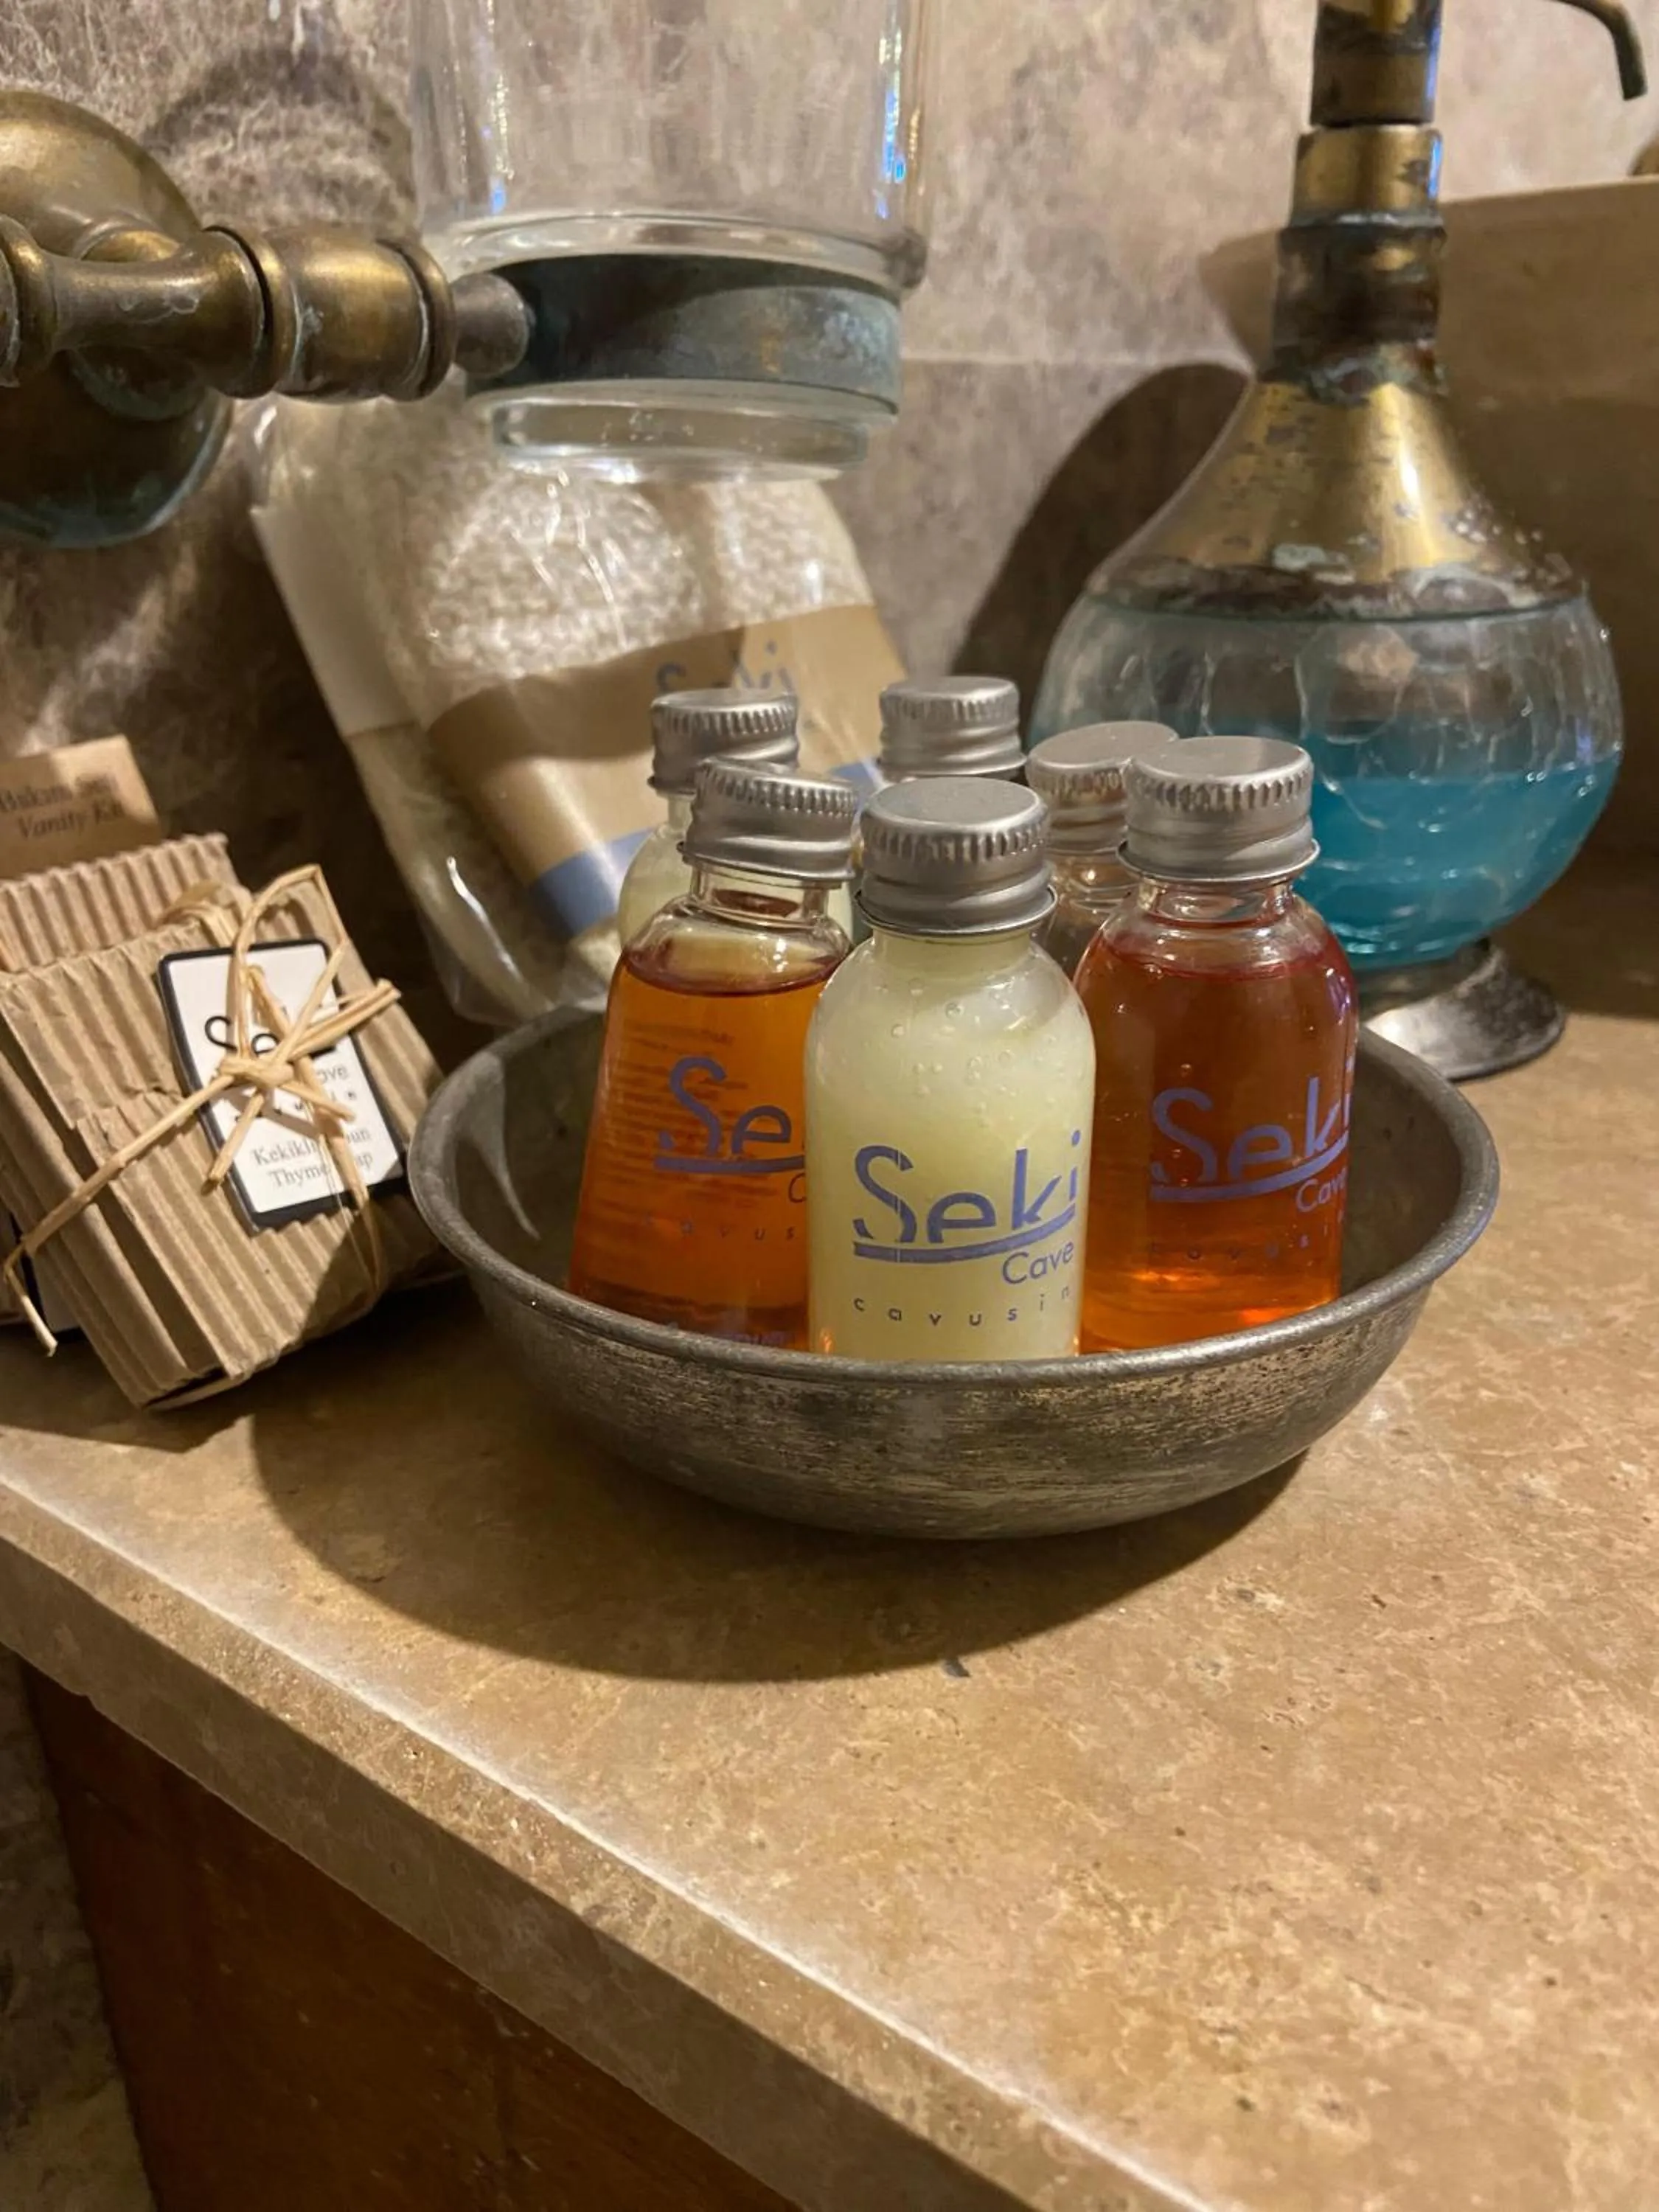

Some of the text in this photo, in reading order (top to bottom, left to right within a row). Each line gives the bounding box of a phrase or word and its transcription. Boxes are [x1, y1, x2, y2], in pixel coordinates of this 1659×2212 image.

[18, 808, 86, 840] Vanity
[657, 1055, 805, 1156] Se
[852, 1129, 1082, 1244] Seki
[1001, 1241, 1074, 1285] Cave
